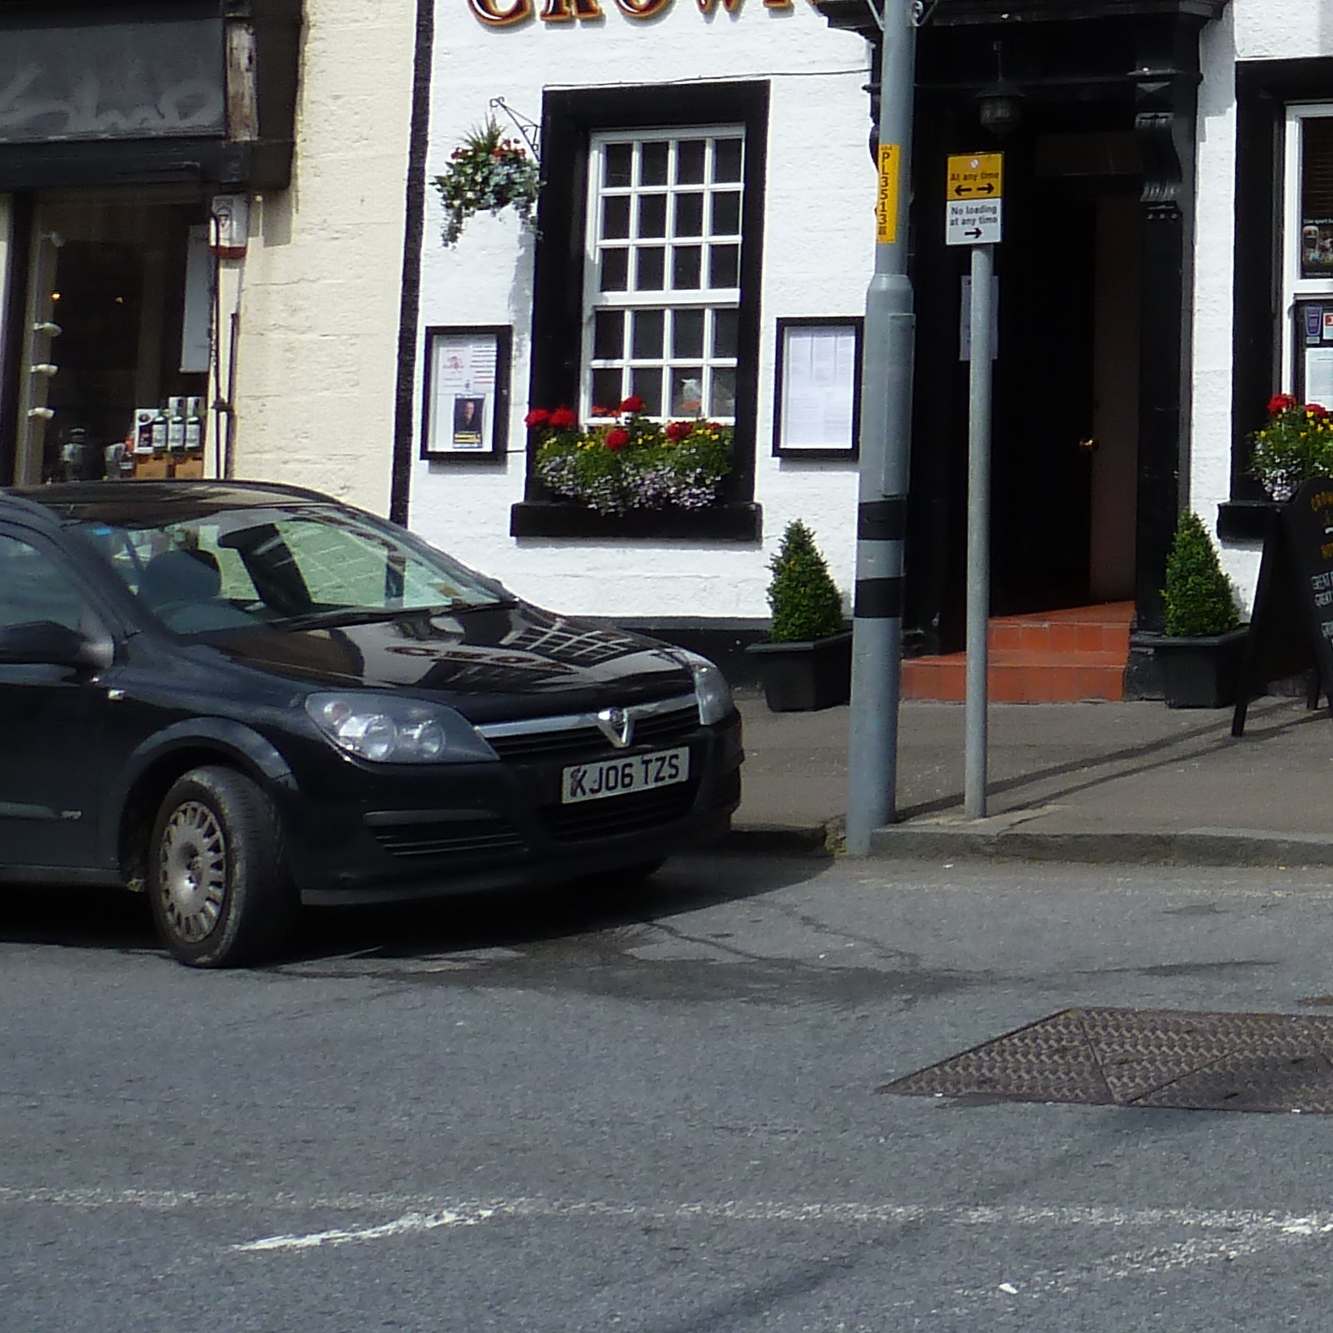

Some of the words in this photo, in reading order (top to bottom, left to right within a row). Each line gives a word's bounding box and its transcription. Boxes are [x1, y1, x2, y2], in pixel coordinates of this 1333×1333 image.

[950, 172, 960, 182] At
[962, 172, 978, 182] any
[980, 171, 999, 180] time
[951, 206, 964, 216] No
[966, 204, 997, 215] loading
[950, 217, 959, 226] at
[961, 217, 977, 227] any
[979, 215, 998, 225] time
[570, 762, 634, 798] KJ06
[641, 754, 680, 785] TZS
